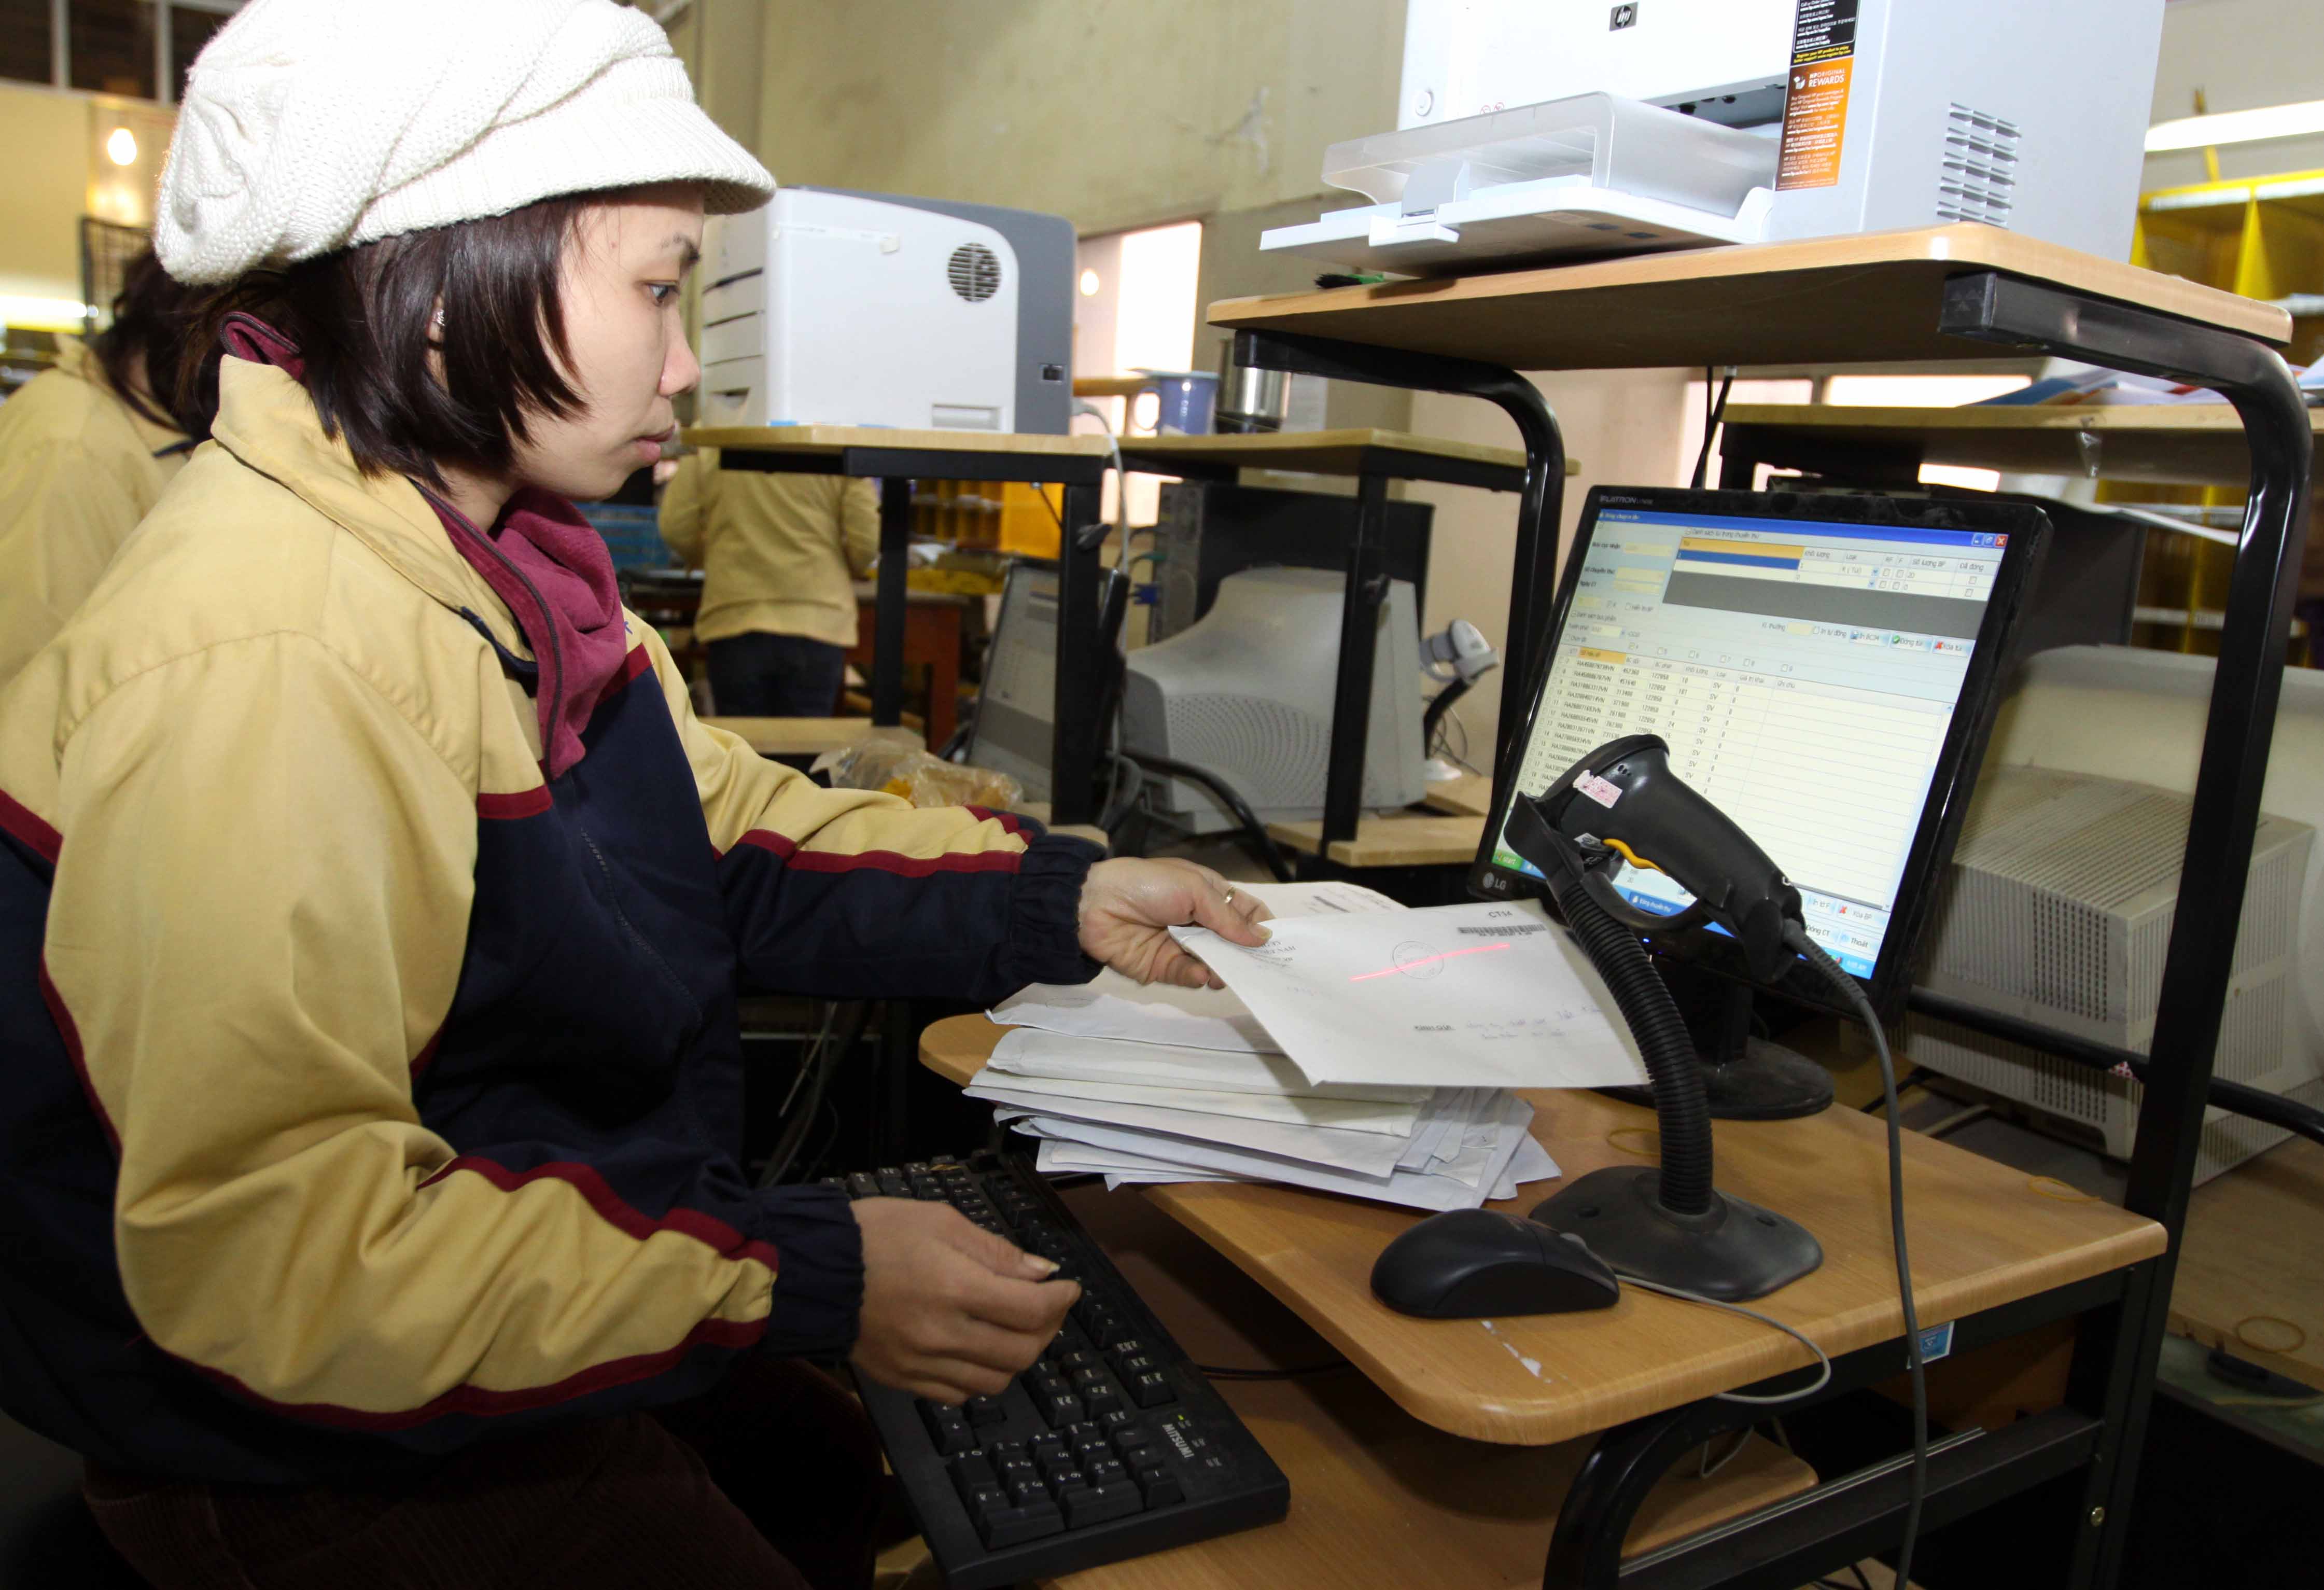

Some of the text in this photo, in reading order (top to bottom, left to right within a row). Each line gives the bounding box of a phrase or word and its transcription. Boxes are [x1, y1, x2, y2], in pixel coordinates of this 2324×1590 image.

[1809, 74, 1845, 87] REWARDS
[1502, 857, 1516, 865] start
[1494, 877, 1507, 891] LG
[1488, 910, 1514, 918] CT14
[1161, 1424, 1195, 1458] MITSUMI
